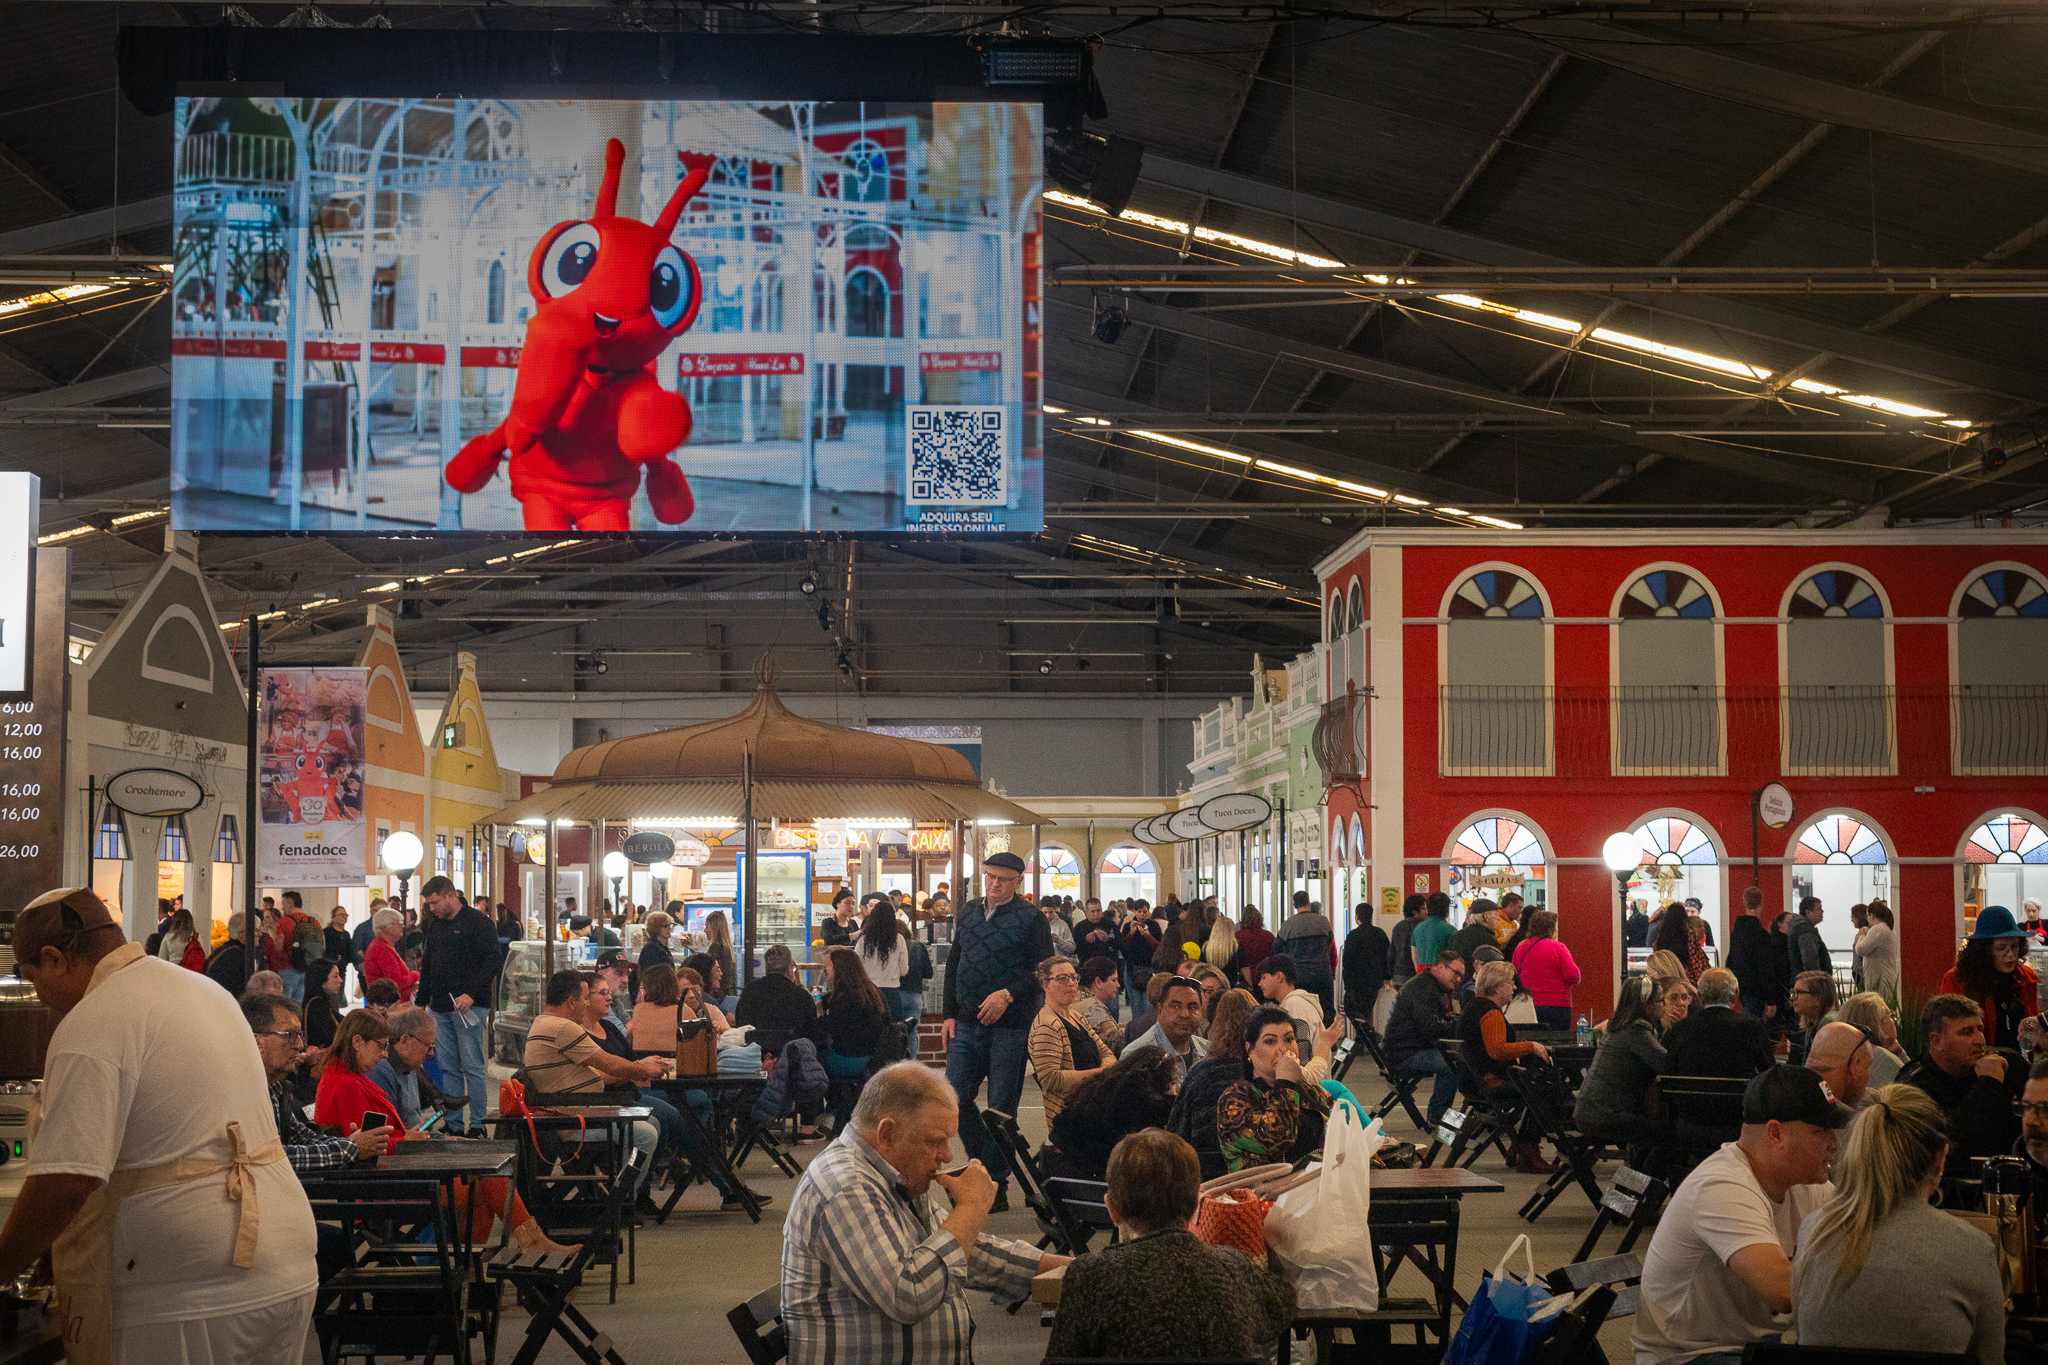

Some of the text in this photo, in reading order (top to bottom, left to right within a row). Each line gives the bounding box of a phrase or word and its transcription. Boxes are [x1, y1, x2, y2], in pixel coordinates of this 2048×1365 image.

[919, 512, 993, 523] ADQUIRA SEU
[906, 524, 1006, 532] INGRESSO ONLINE
[2, 702, 34, 714] 6,00
[3, 724, 42, 738] 12,00
[3, 747, 42, 761] 16,00
[2, 784, 41, 798] 16,00
[125, 785, 186, 798] Crochemore
[302, 798, 323, 811] 30
[1, 808, 40, 822] 16,00
[1213, 807, 1256, 818] Tuca Doces
[775, 828, 871, 849] BEROLA
[909, 831, 952, 850] CAIXA
[0, 845, 39, 859] 26,00
[279, 844, 347, 856] fenadoce
[627, 843, 671, 854] BEROLA
